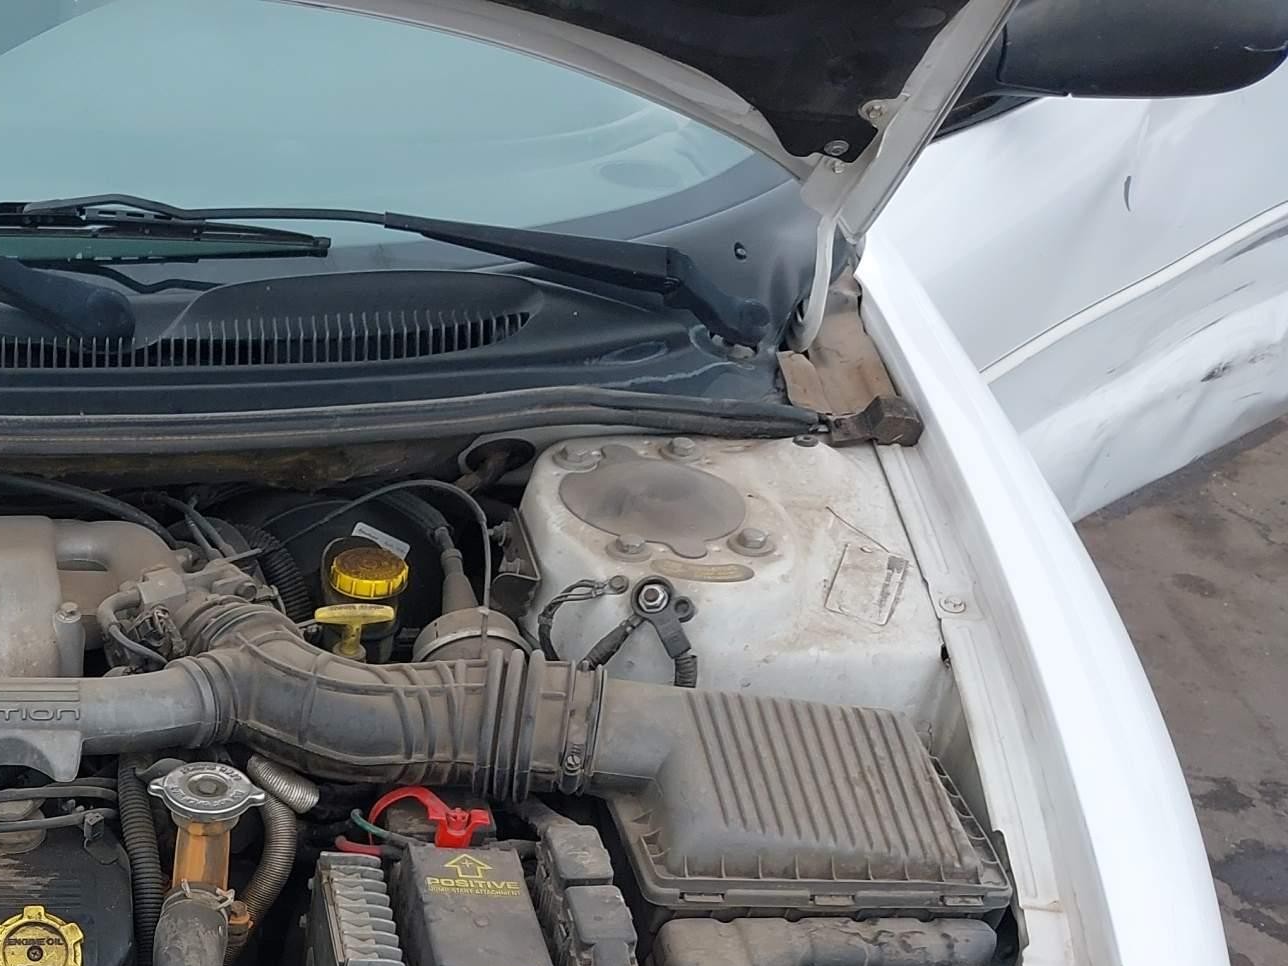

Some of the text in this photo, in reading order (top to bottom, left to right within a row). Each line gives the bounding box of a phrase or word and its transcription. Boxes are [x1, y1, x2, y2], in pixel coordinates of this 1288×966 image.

[425, 877, 521, 890] POSITIVE
[6, 937, 64, 946] ENGINE OIL
